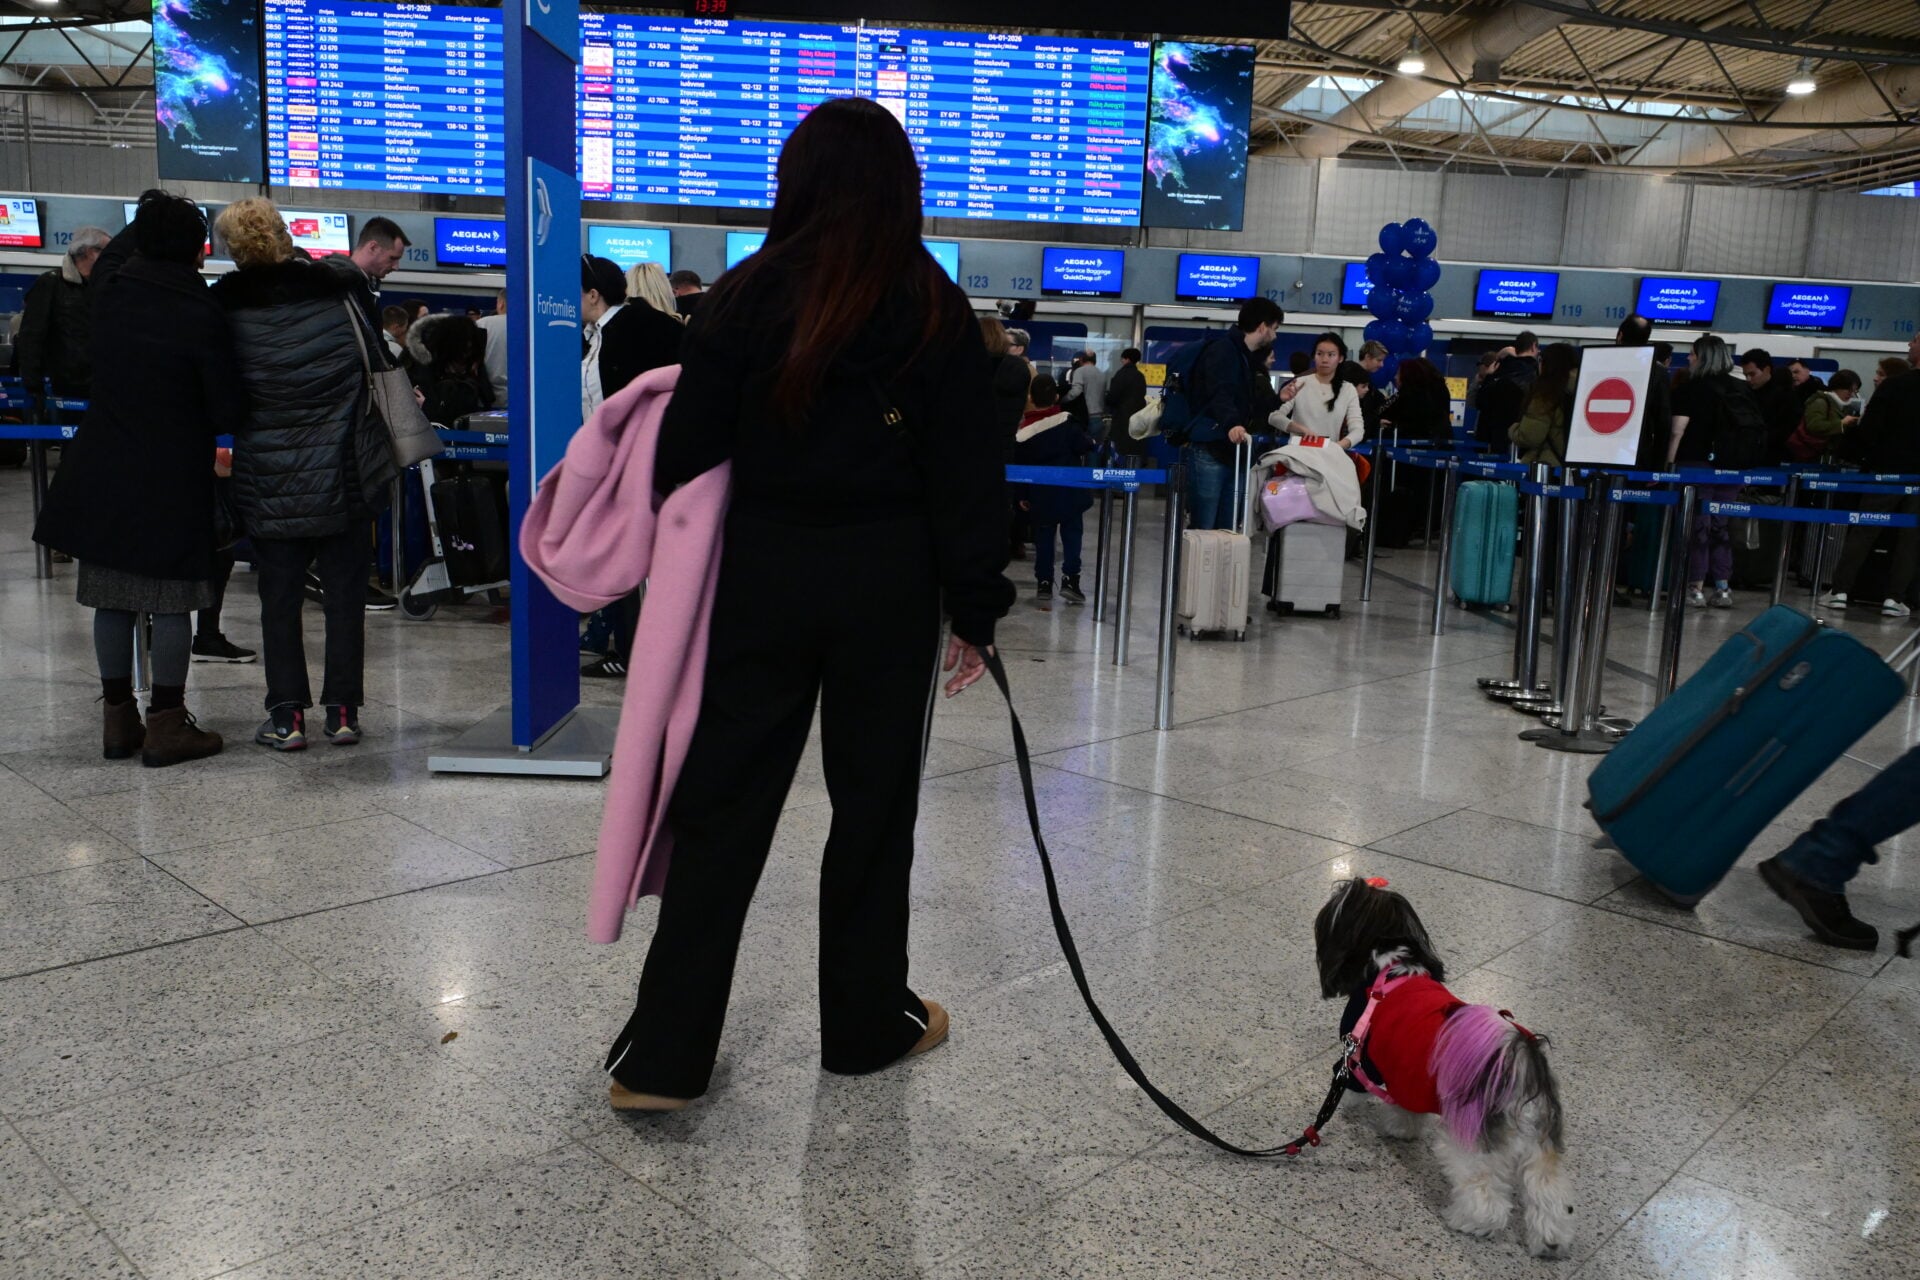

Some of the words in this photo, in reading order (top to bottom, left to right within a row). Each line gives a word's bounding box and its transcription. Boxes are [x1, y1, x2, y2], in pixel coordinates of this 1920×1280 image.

[452, 230, 491, 239] AEGEAN
[446, 242, 473, 253] Special
[406, 248, 429, 262] 126
[968, 275, 989, 288] 123
[1011, 278, 1033, 290] 122
[1264, 290, 1285, 302] 121
[1312, 293, 1333, 305] 120
[537, 294, 576, 318] ForFamilies
[1561, 304, 1581, 317] 119
[1605, 307, 1625, 319] 118
[1851, 318, 1872, 331] 117
[1894, 320, 1913, 332] 116
